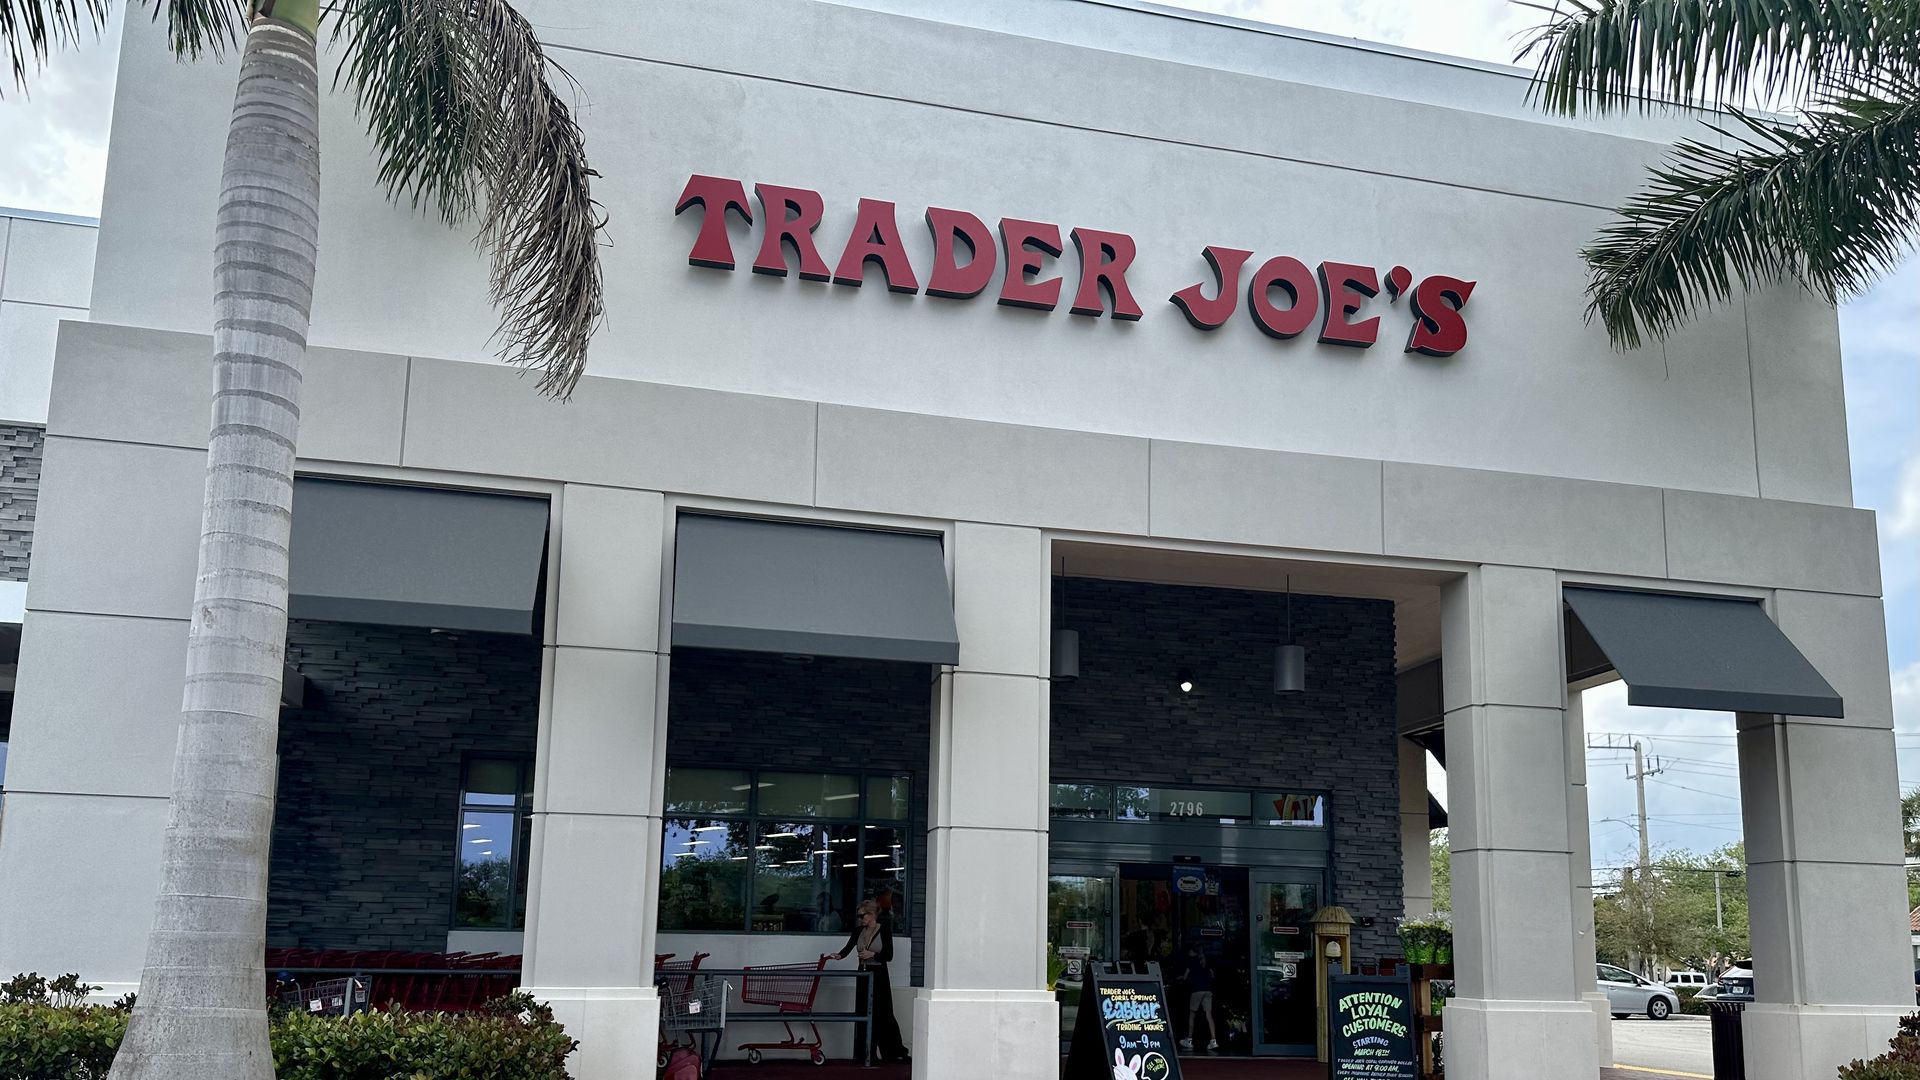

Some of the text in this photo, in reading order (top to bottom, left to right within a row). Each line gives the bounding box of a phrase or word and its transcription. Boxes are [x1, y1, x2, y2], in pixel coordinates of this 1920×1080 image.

[675, 174, 1477, 357] TRADER JOE'S
[1169, 801, 1204, 817] 2796
[1102, 998, 1160, 1020] Easter
[1339, 992, 1403, 1013] ATTENTION
[1351, 1004, 1390, 1020] LOYAL
[1116, 1023, 1142, 1031] TRADING
[1353, 1036, 1389, 1049] STARTING
[1354, 1048, 1375, 1057] MARCH
